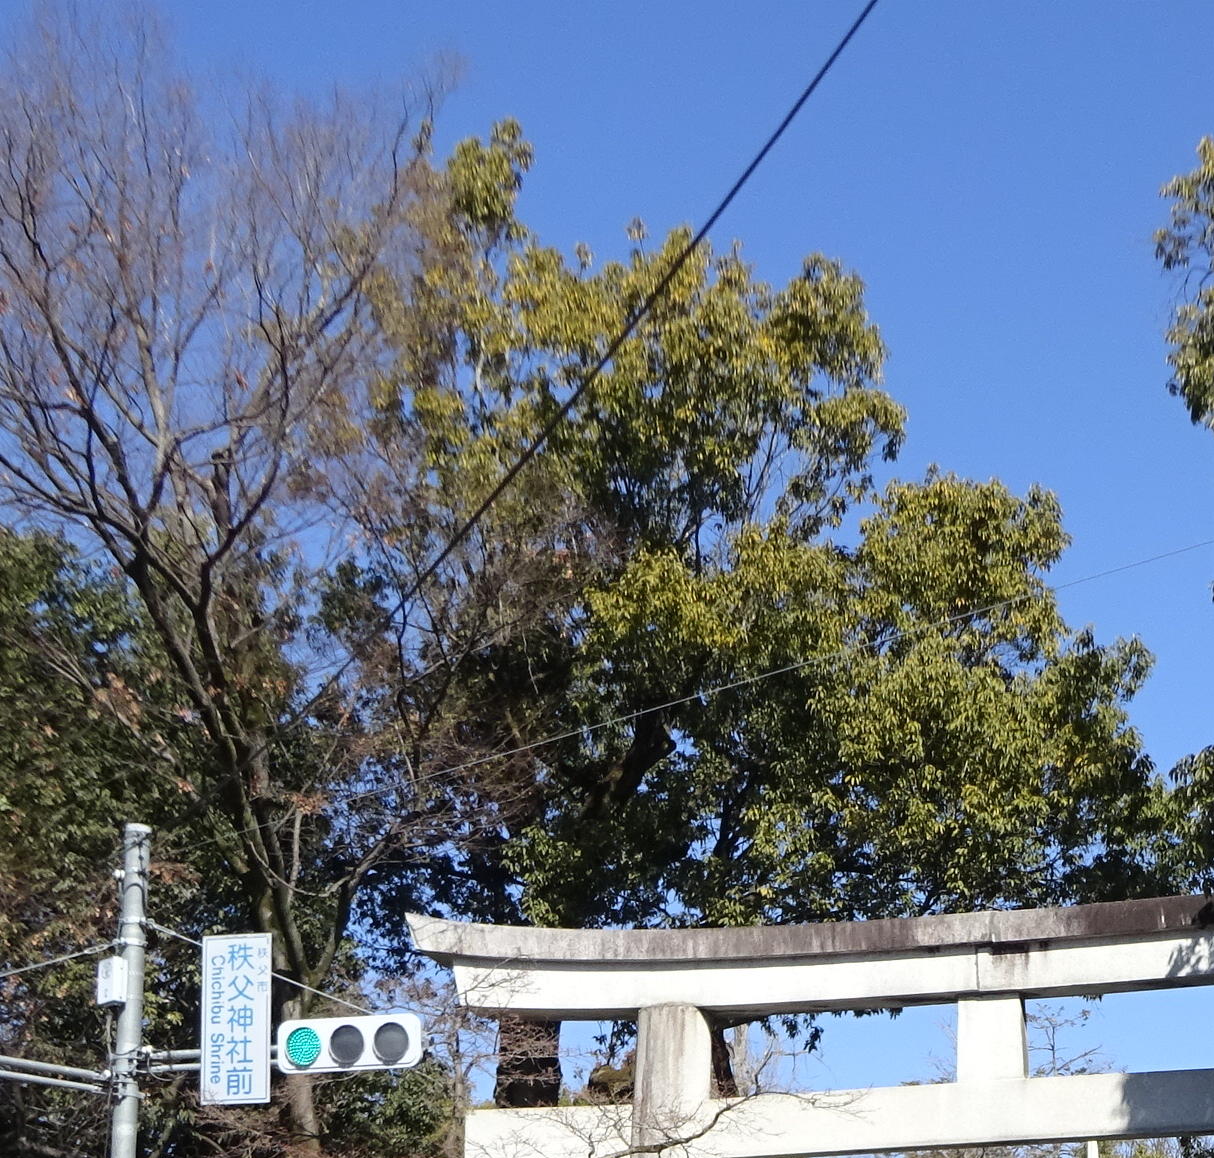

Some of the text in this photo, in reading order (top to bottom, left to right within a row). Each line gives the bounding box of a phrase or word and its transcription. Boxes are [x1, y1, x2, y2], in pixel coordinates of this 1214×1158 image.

[210, 954, 225, 1085] Chichibu Shrine
[226, 943, 255, 1096] 秩父神社前
[257, 947, 269, 993] 秩父市
